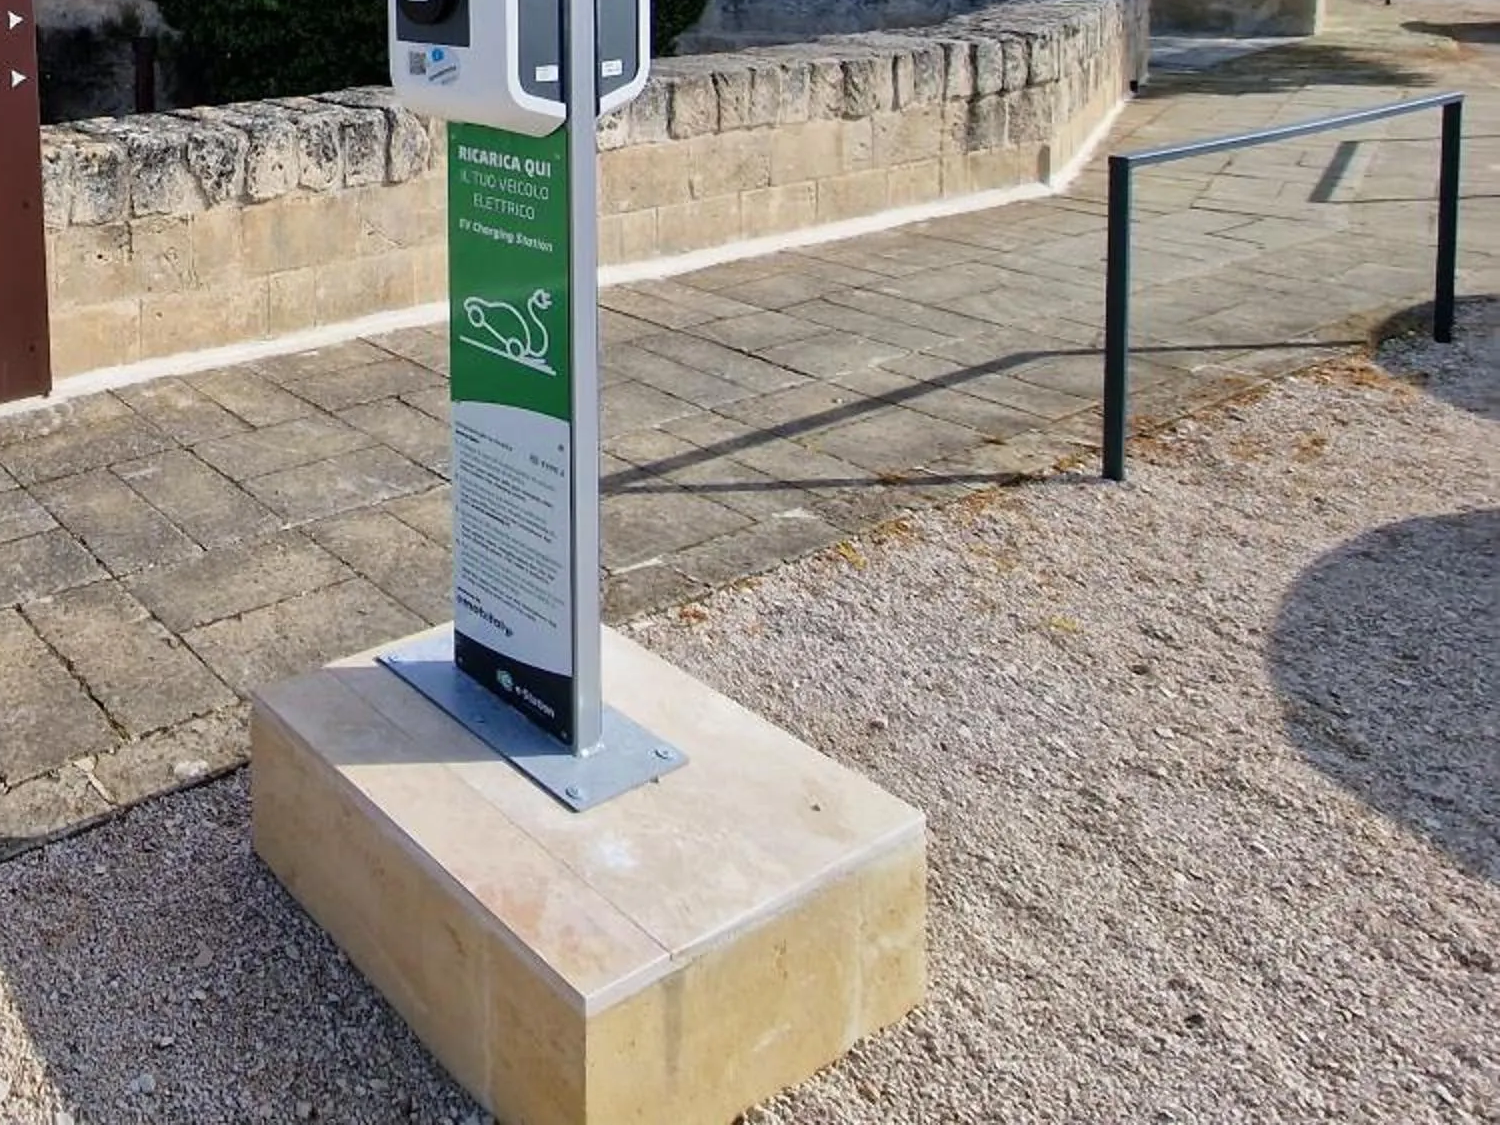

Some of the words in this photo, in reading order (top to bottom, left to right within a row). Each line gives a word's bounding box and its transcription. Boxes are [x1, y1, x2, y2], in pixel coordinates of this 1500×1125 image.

[458, 145, 521, 171] RICARICA
[524, 159, 552, 178] QUI
[460, 170, 470, 184] IL
[471, 171, 497, 188] TUO
[499, 178, 549, 200] VEICOLO
[473, 192, 535, 220] ELETTRICO
[472, 221, 515, 244] Charging
[516, 233, 553, 252] Station
